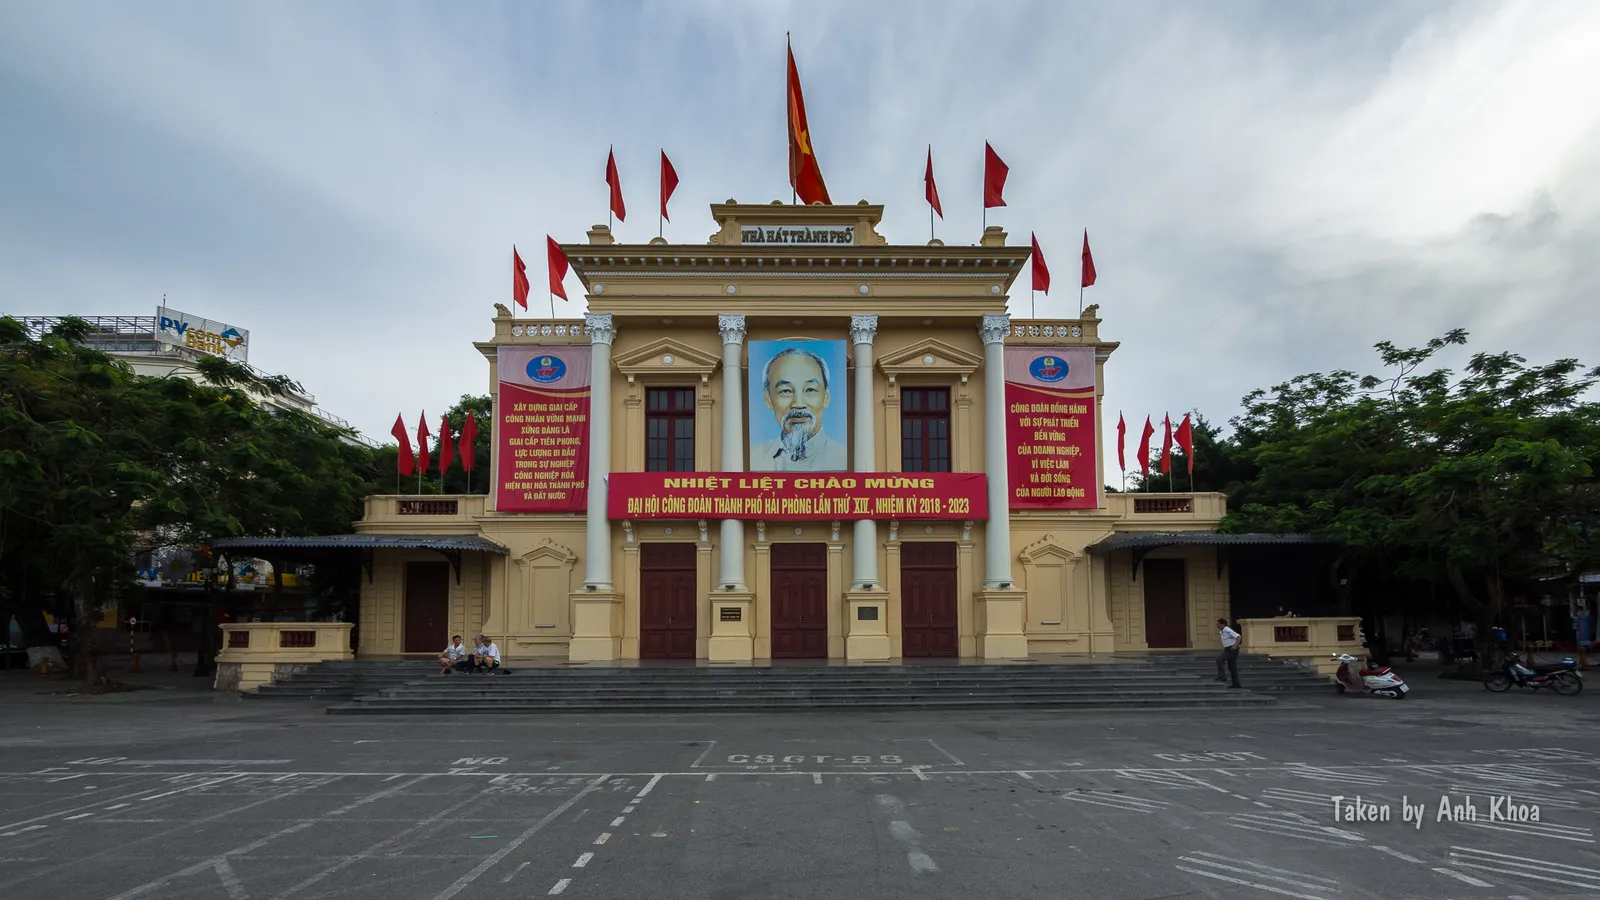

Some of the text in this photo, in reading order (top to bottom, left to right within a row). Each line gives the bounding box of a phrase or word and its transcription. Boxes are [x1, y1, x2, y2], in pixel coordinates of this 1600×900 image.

[741, 227, 854, 243] NHÀ HÁT THÀNH PHỐ
[186, 335, 227, 355] Bank
[513, 400, 578, 413] XÂY DỰNG GIAI CẤP
[1010, 402, 1030, 414] CÔNG
[1031, 402, 1050, 414] ĐOÀN
[1069, 403, 1087, 414] HÀNH
[505, 413, 586, 424] CÔNG NHÂN VỮNG MẠNH
[1019, 416, 1031, 427] VỚI
[1032, 417, 1043, 430] SỰ
[1043, 417, 1060, 427] PHÁT
[521, 424, 570, 434] XỨNG ĐÁNG LÀ
[524, 435, 538, 445] CẤP
[540, 437, 556, 445] TIÊN
[1048, 431, 1066, 441] VỮNG
[515, 448, 528, 458] LỰC
[529, 448, 552, 458] LƯỢNG
[1017, 443, 1032, 455] CỦA
[1033, 446, 1055, 455] DOANH
[539, 460, 549, 469] SỰ
[550, 460, 575, 470] NGHIỆP
[1031, 458, 1070, 471] VÌ VIỆC LÀM
[514, 470, 575, 481] CÔNG NGHIỆP HÓA
[1030, 470, 1071, 483] VÀ ĐỜI SỐNG
[505, 479, 586, 491] HIỆN ĐẠI HÓA THÀNH PHỐ
[664, 476, 935, 490] NHIỆT LIỆT CHÀO MỪNG
[523, 490, 566, 500] VÀ ĐẤT NƯỚC
[1016, 485, 1085, 499] CỦA NGƯỜI LAO ĐỘNG
[628, 497, 643, 517] ĐẠI
[644, 494, 660, 517] HỘI
[662, 494, 686, 513] CÔNG
[688, 495, 712, 513] ĐOÀN
[714, 495, 743, 513] THÀNH
[745, 493, 763, 514] PHỐ
[764, 492, 780, 514] HẢI
[782, 494, 811, 514] PHÒNG
[814, 492, 832, 514] LẦN
[833, 493, 851, 514] THỨ
[876, 494, 904, 517] NHIỆM
[906, 494, 918, 513] KỲ
[920, 497, 941, 513] 2018
[949, 497, 970, 513] 2023
